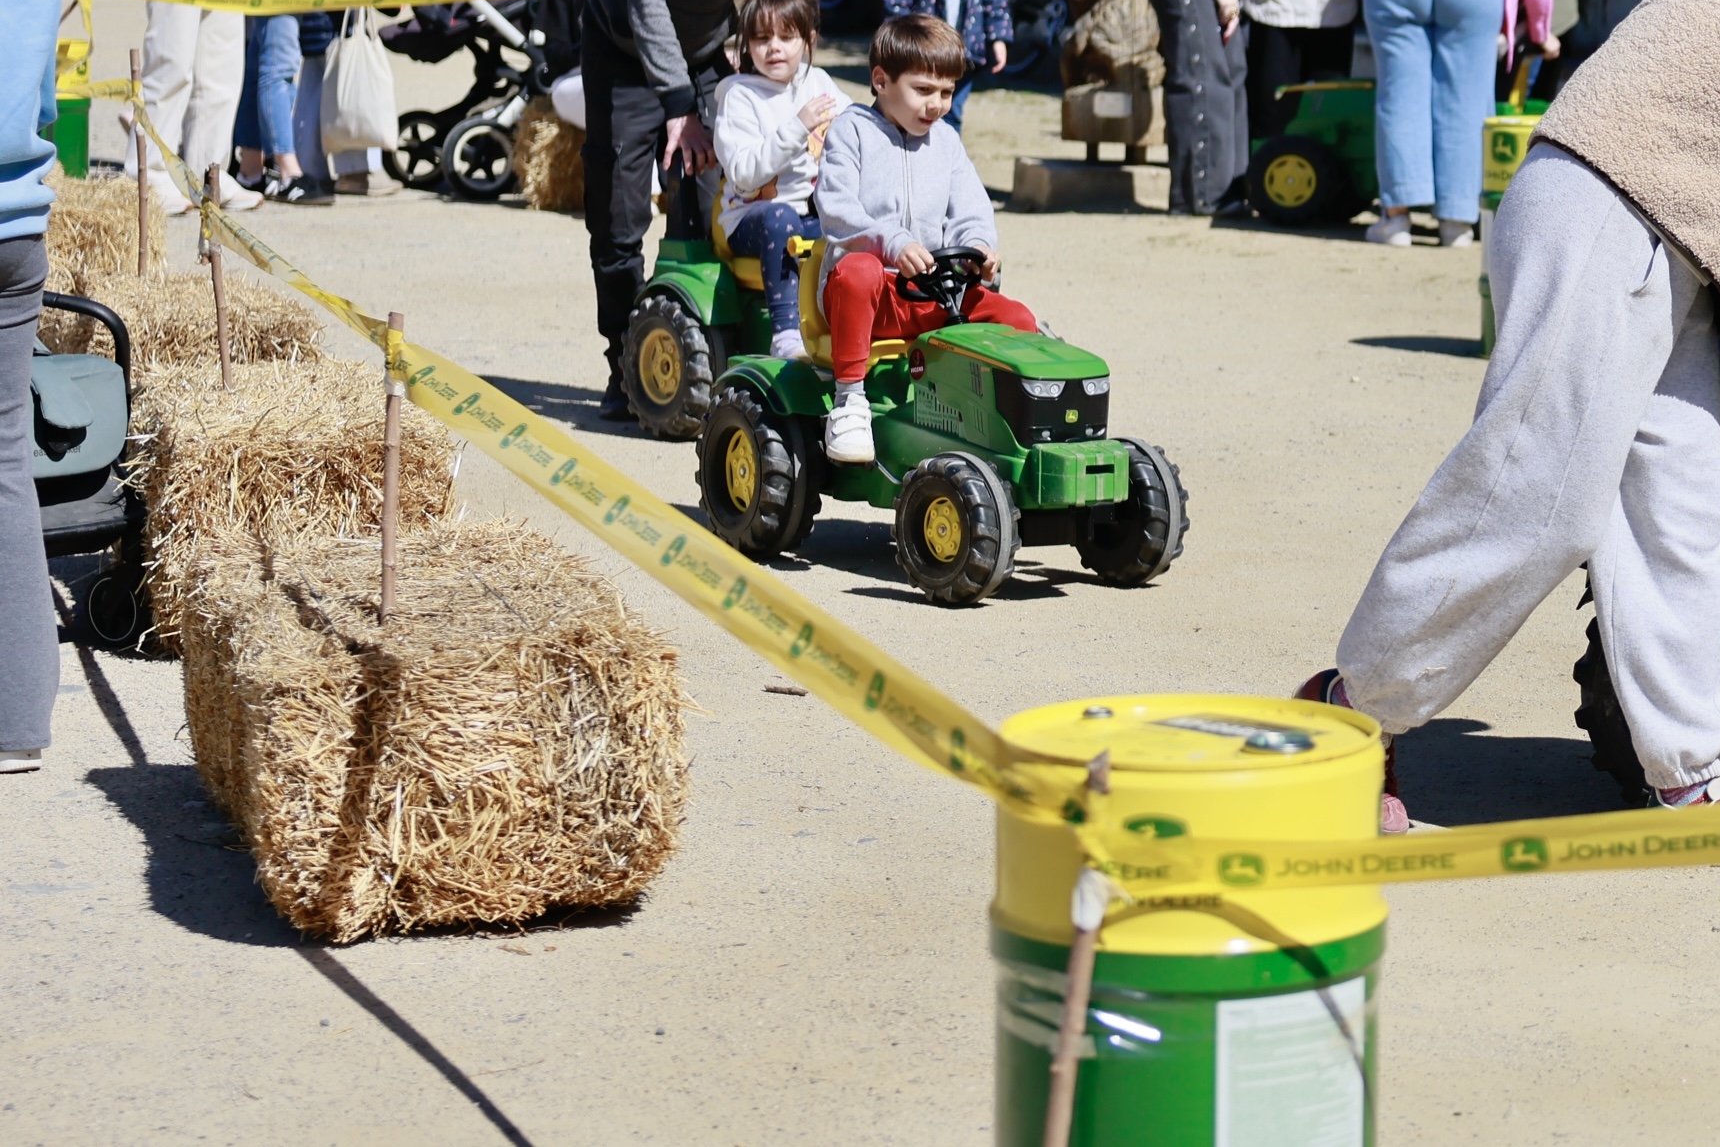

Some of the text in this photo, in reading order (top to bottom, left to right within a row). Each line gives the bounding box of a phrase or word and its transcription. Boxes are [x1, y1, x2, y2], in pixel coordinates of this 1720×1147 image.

[1559, 837, 1637, 862] JOHN
[1275, 852, 1458, 878] JOHN DEERE
